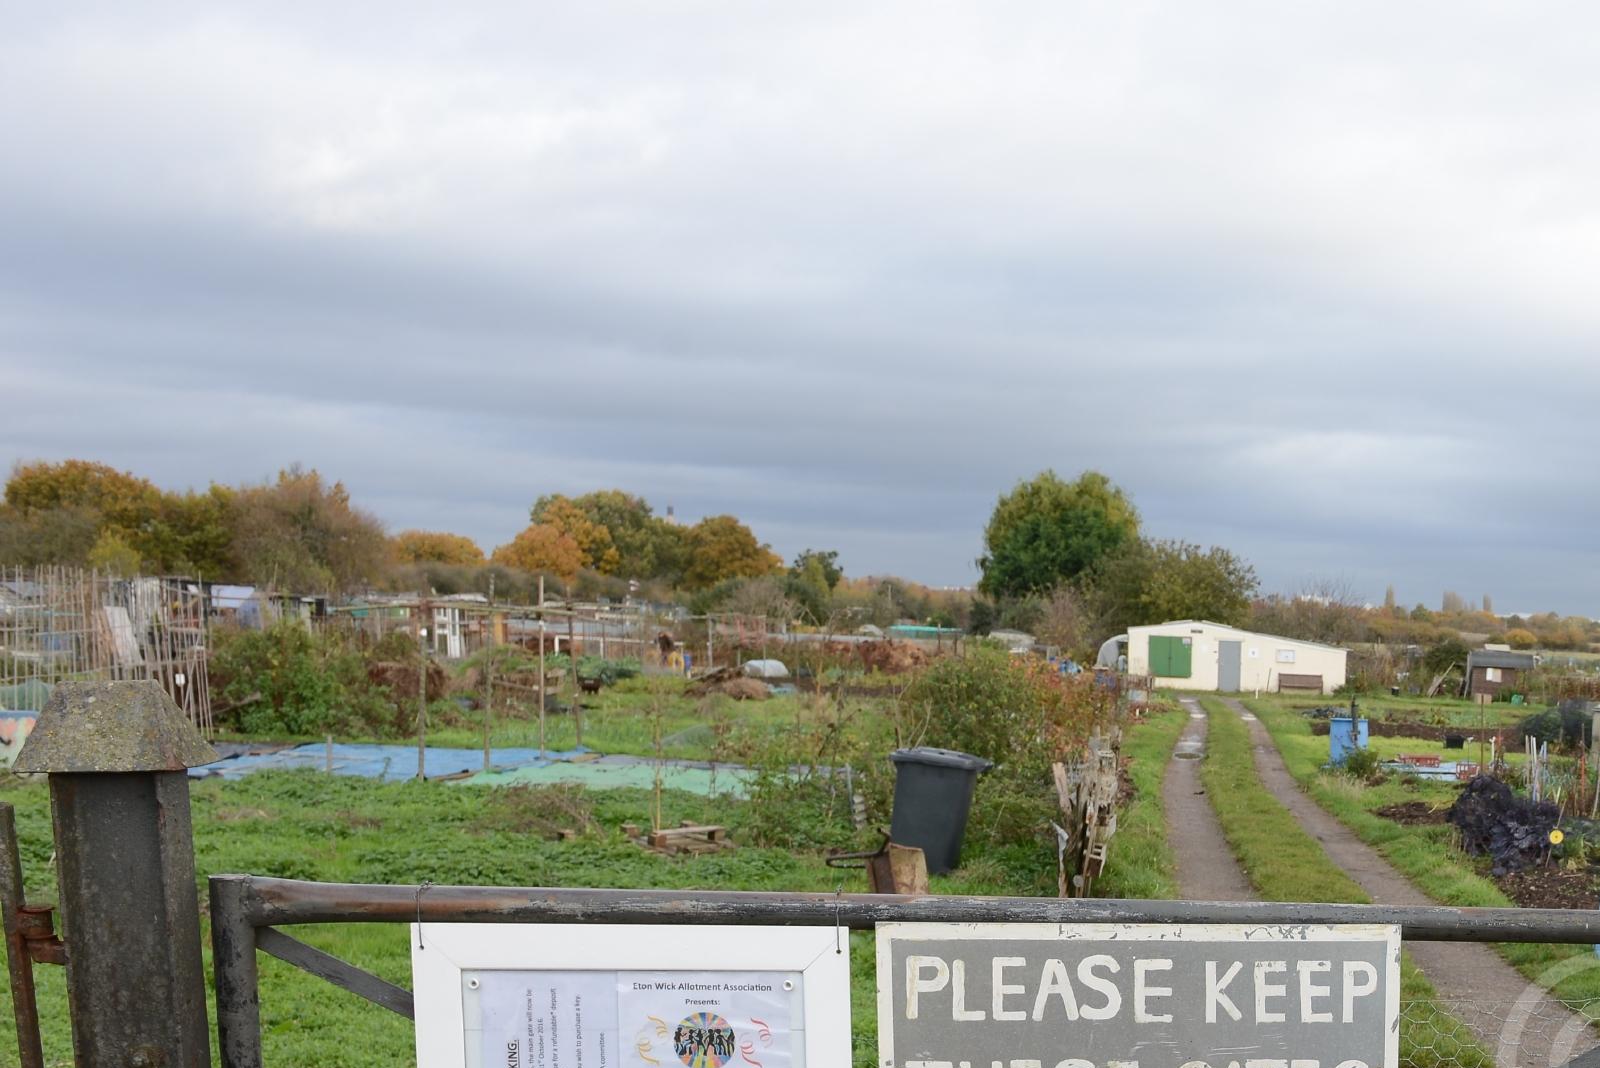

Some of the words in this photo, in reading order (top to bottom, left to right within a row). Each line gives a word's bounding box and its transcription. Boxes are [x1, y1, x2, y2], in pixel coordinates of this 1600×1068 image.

[633, 982, 652, 990] Eton
[678, 983, 720, 991] Allotment
[724, 984, 772, 992] Association
[906, 954, 1173, 1023] PLEASE
[1206, 960, 1378, 1025] KEEP
